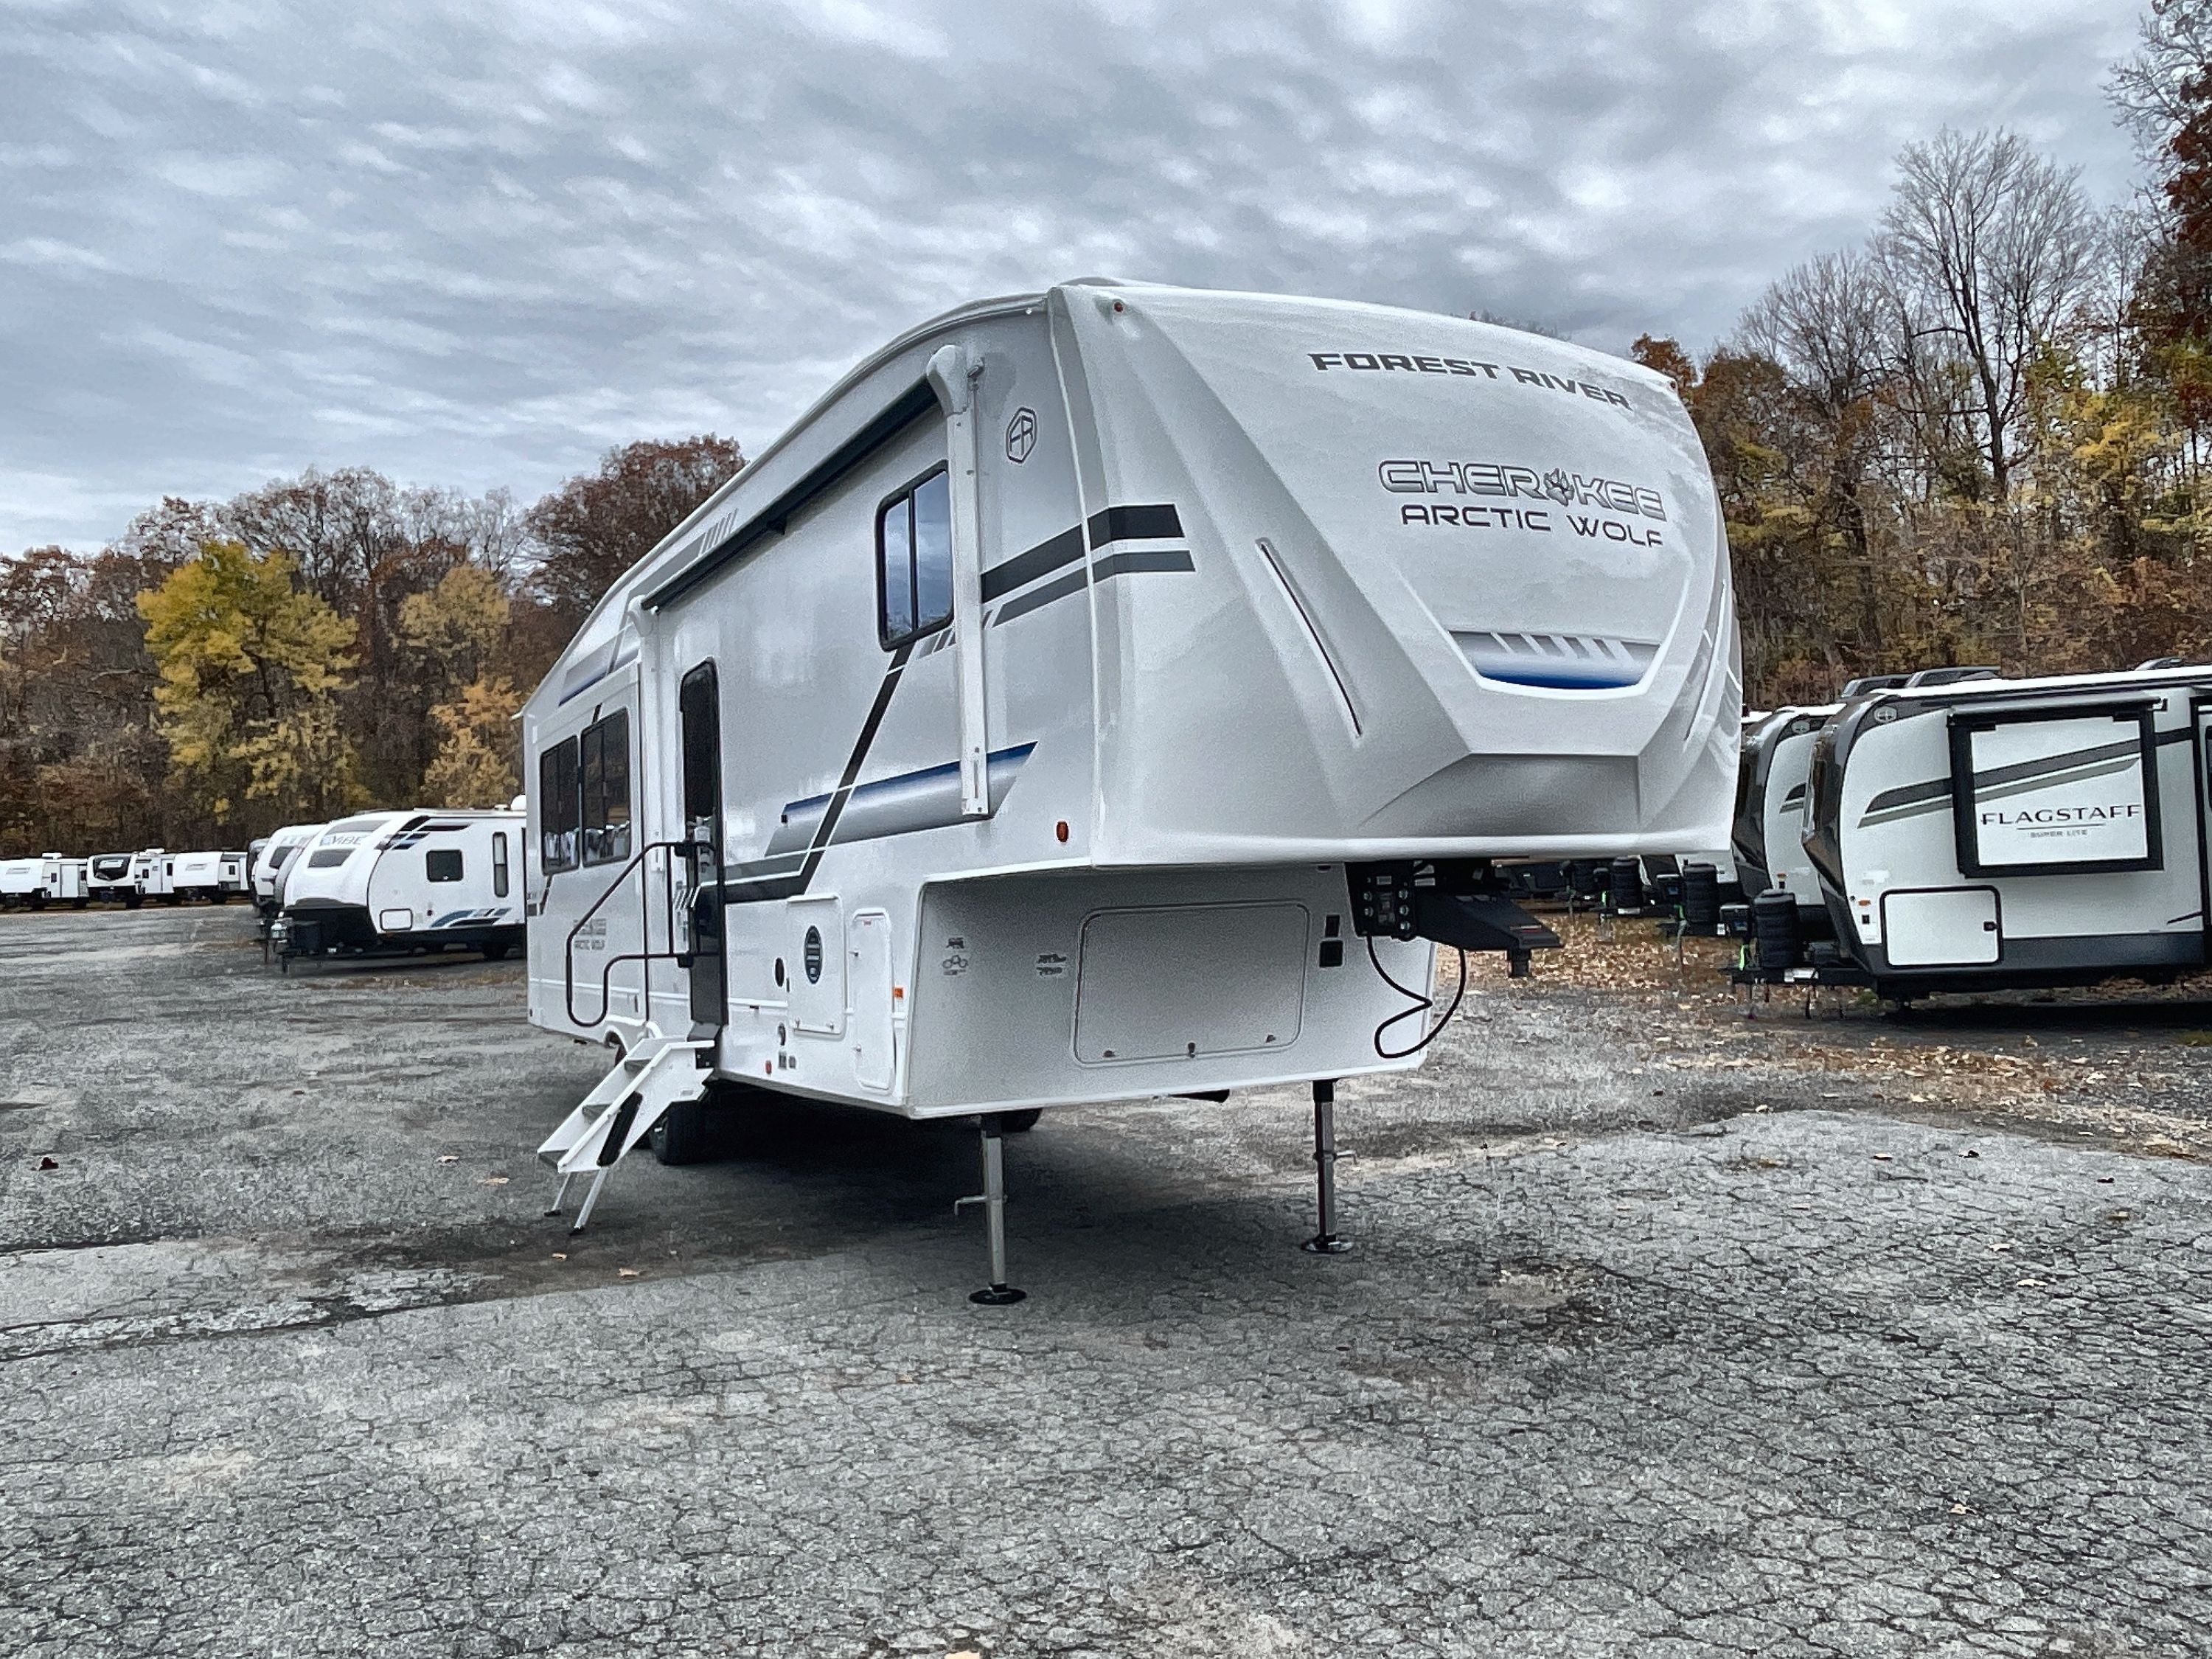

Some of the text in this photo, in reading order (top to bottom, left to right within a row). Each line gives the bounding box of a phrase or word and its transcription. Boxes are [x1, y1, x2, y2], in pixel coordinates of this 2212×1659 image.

[1307, 352, 1633, 411] FOREST RIVER
[1401, 504, 1663, 548] ARCTIC WOLF
[1981, 804, 2142, 825] FLAGSTAFF
[2029, 830, 2088, 838] SUPER LITE
